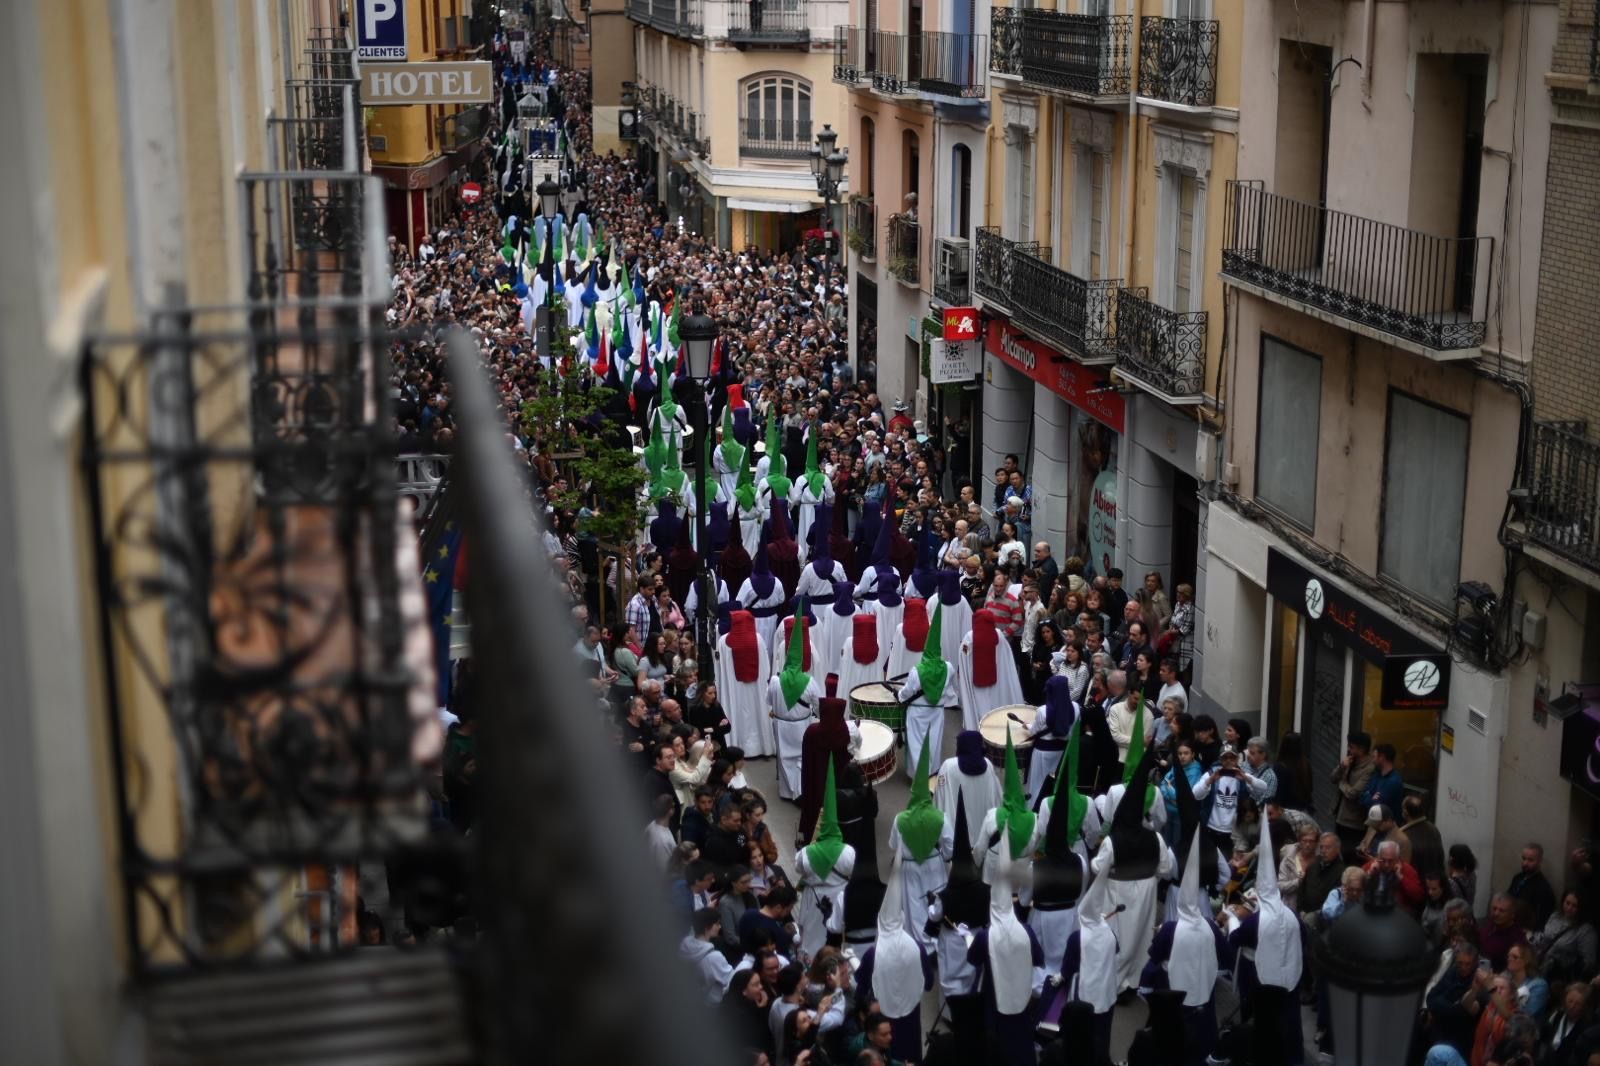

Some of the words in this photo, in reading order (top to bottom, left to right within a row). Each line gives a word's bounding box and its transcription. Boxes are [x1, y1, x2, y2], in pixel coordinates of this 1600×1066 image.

[364, 0, 397, 40] P
[358, 47, 405, 57] CLIENTES
[370, 70, 482, 97] HOTEL
[1001, 327, 1035, 371] Alcampo
[939, 367, 970, 376] PIZZERIA
[1093, 487, 1117, 520] Abiert
